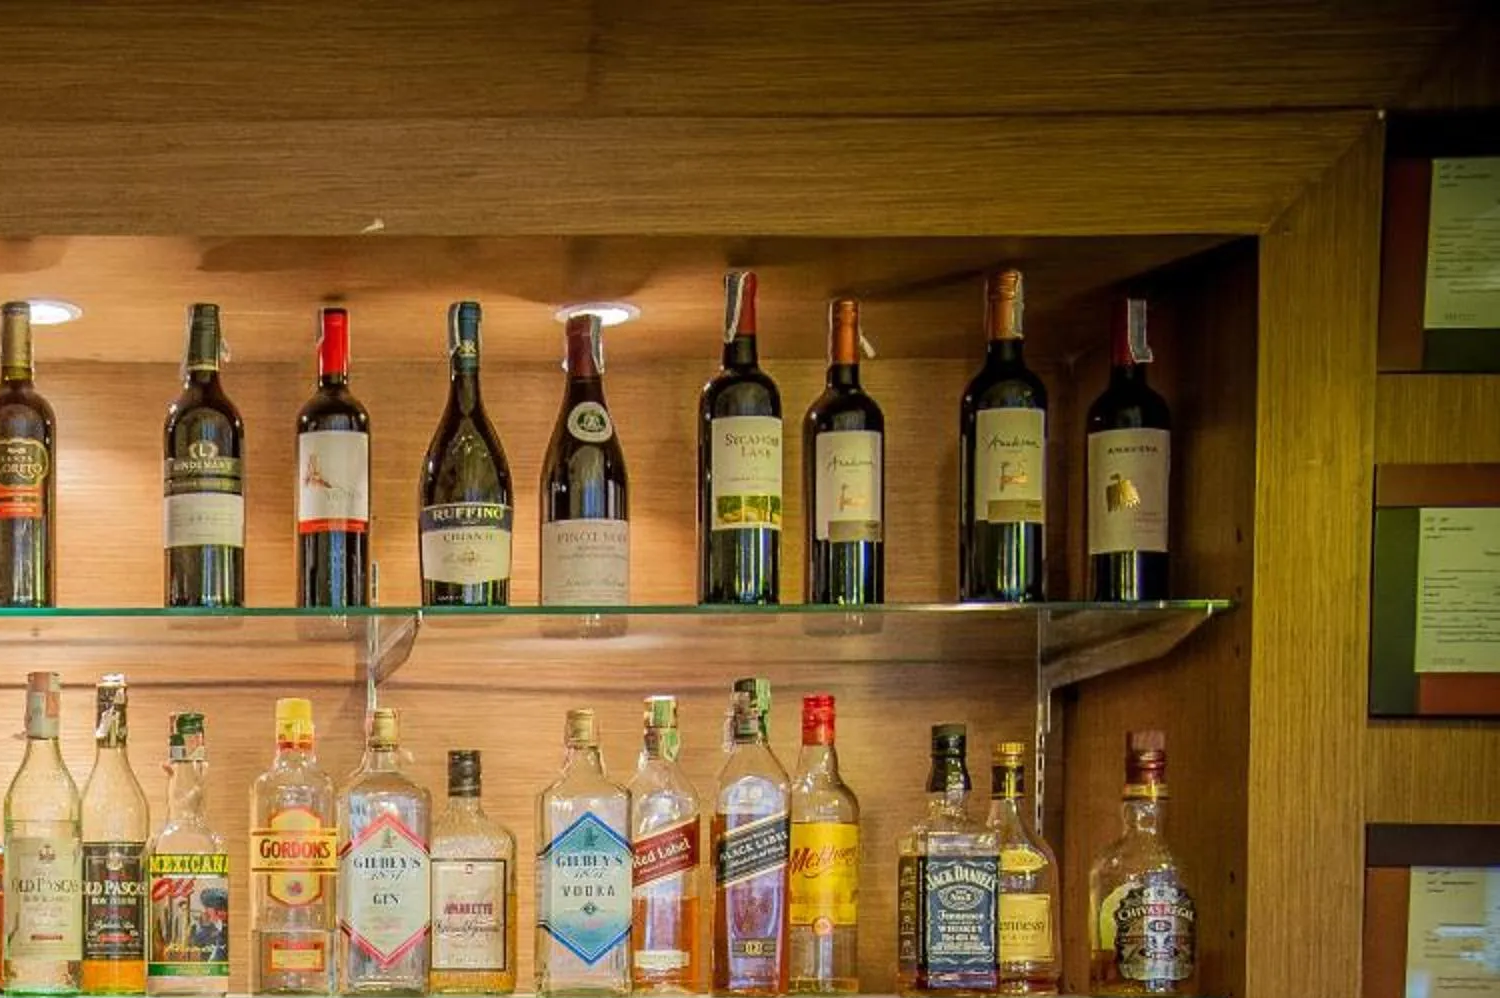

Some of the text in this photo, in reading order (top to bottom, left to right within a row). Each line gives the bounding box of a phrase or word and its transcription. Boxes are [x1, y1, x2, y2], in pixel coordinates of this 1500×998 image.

[432, 507, 505, 520] RUFFINO
[353, 856, 421, 869] GILBEY'S
[563, 884, 615, 897] VODKA
[373, 894, 399, 905] GIN
[1000, 920, 1045, 934] ennessy
